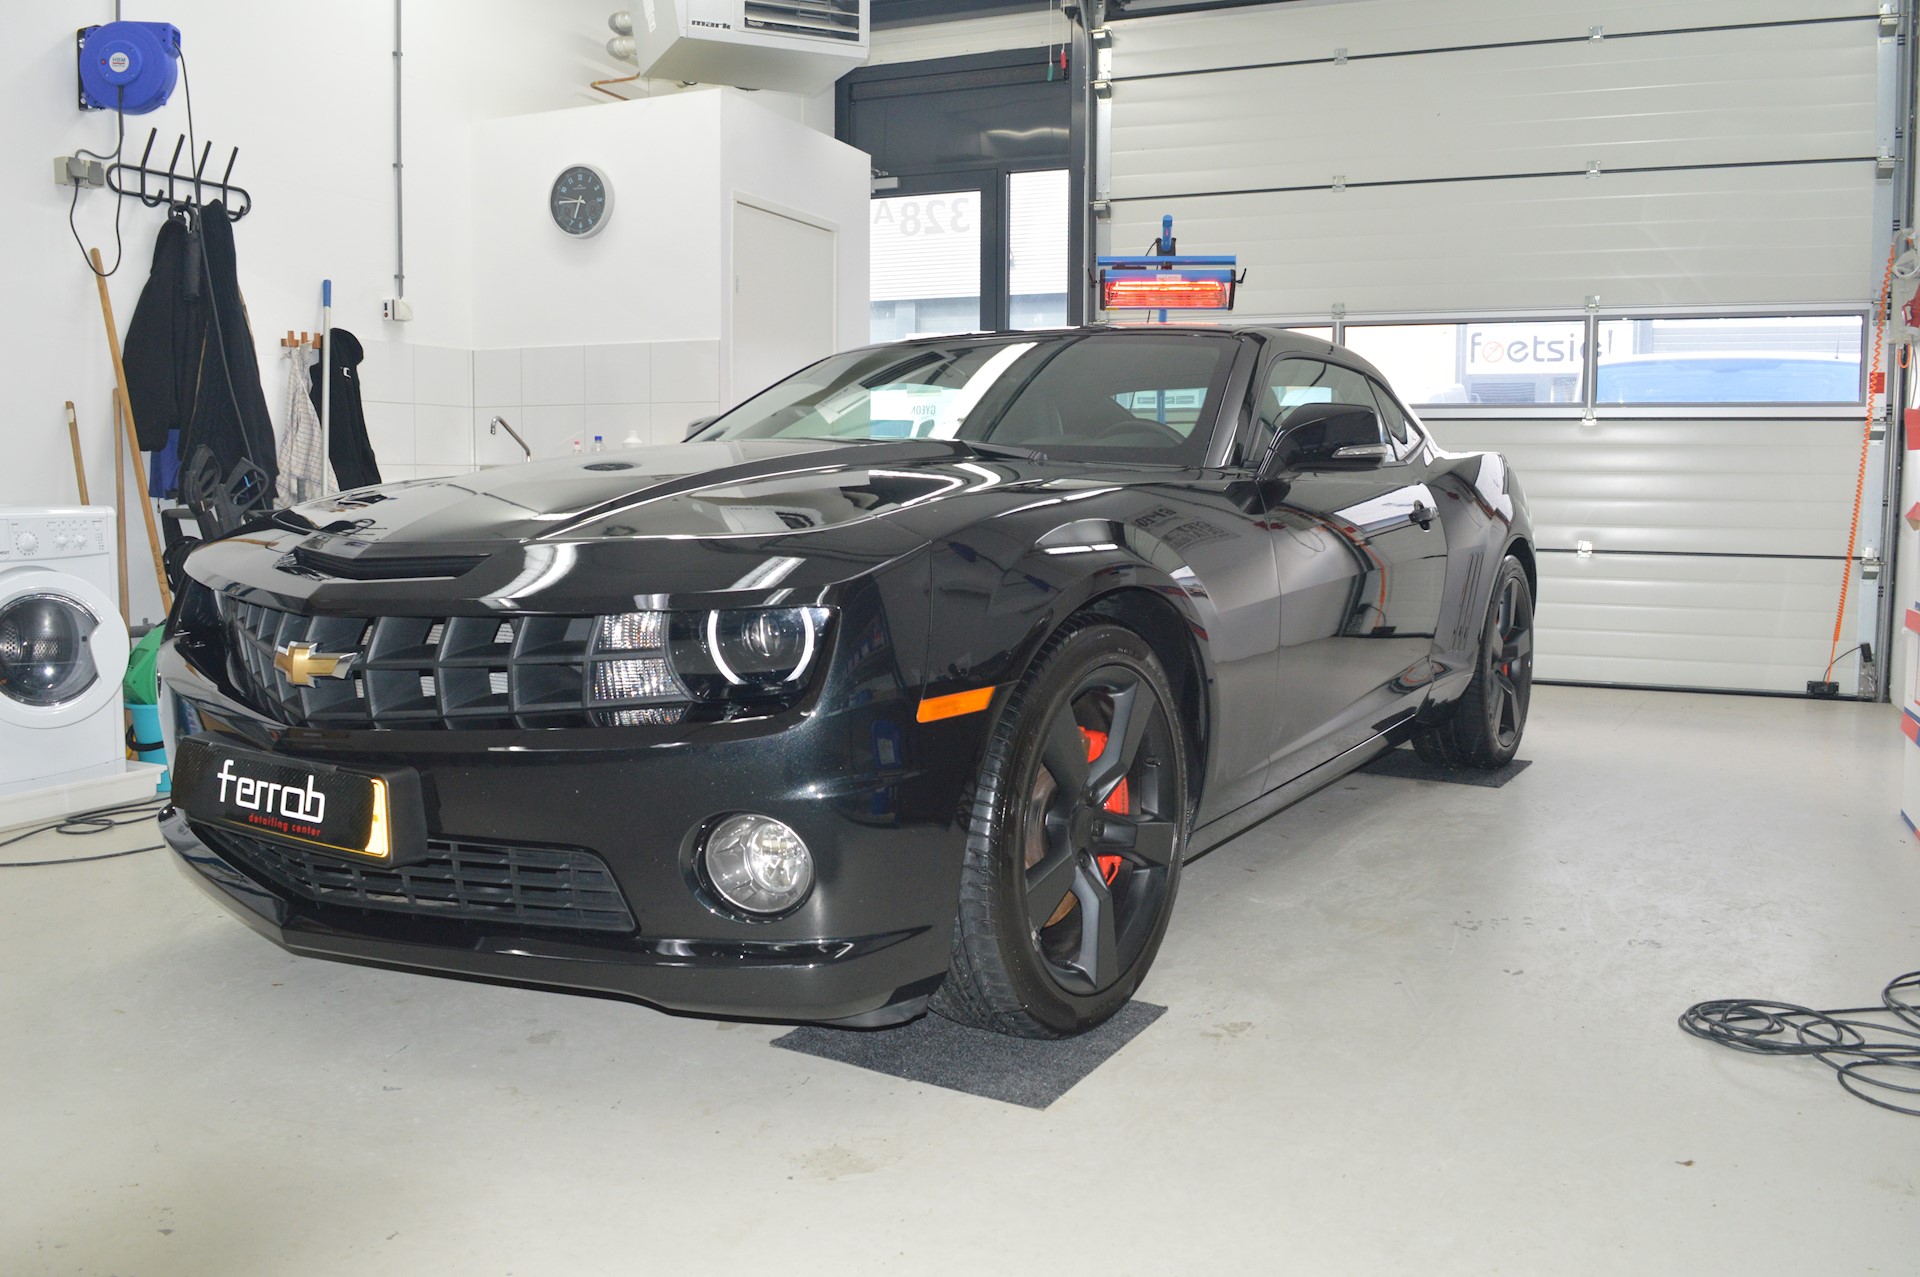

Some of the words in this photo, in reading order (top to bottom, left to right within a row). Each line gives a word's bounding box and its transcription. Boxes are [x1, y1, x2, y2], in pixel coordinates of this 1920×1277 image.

[217, 759, 326, 824] ferrob
[248, 813, 289, 832] detailing
[291, 824, 321, 837] center
